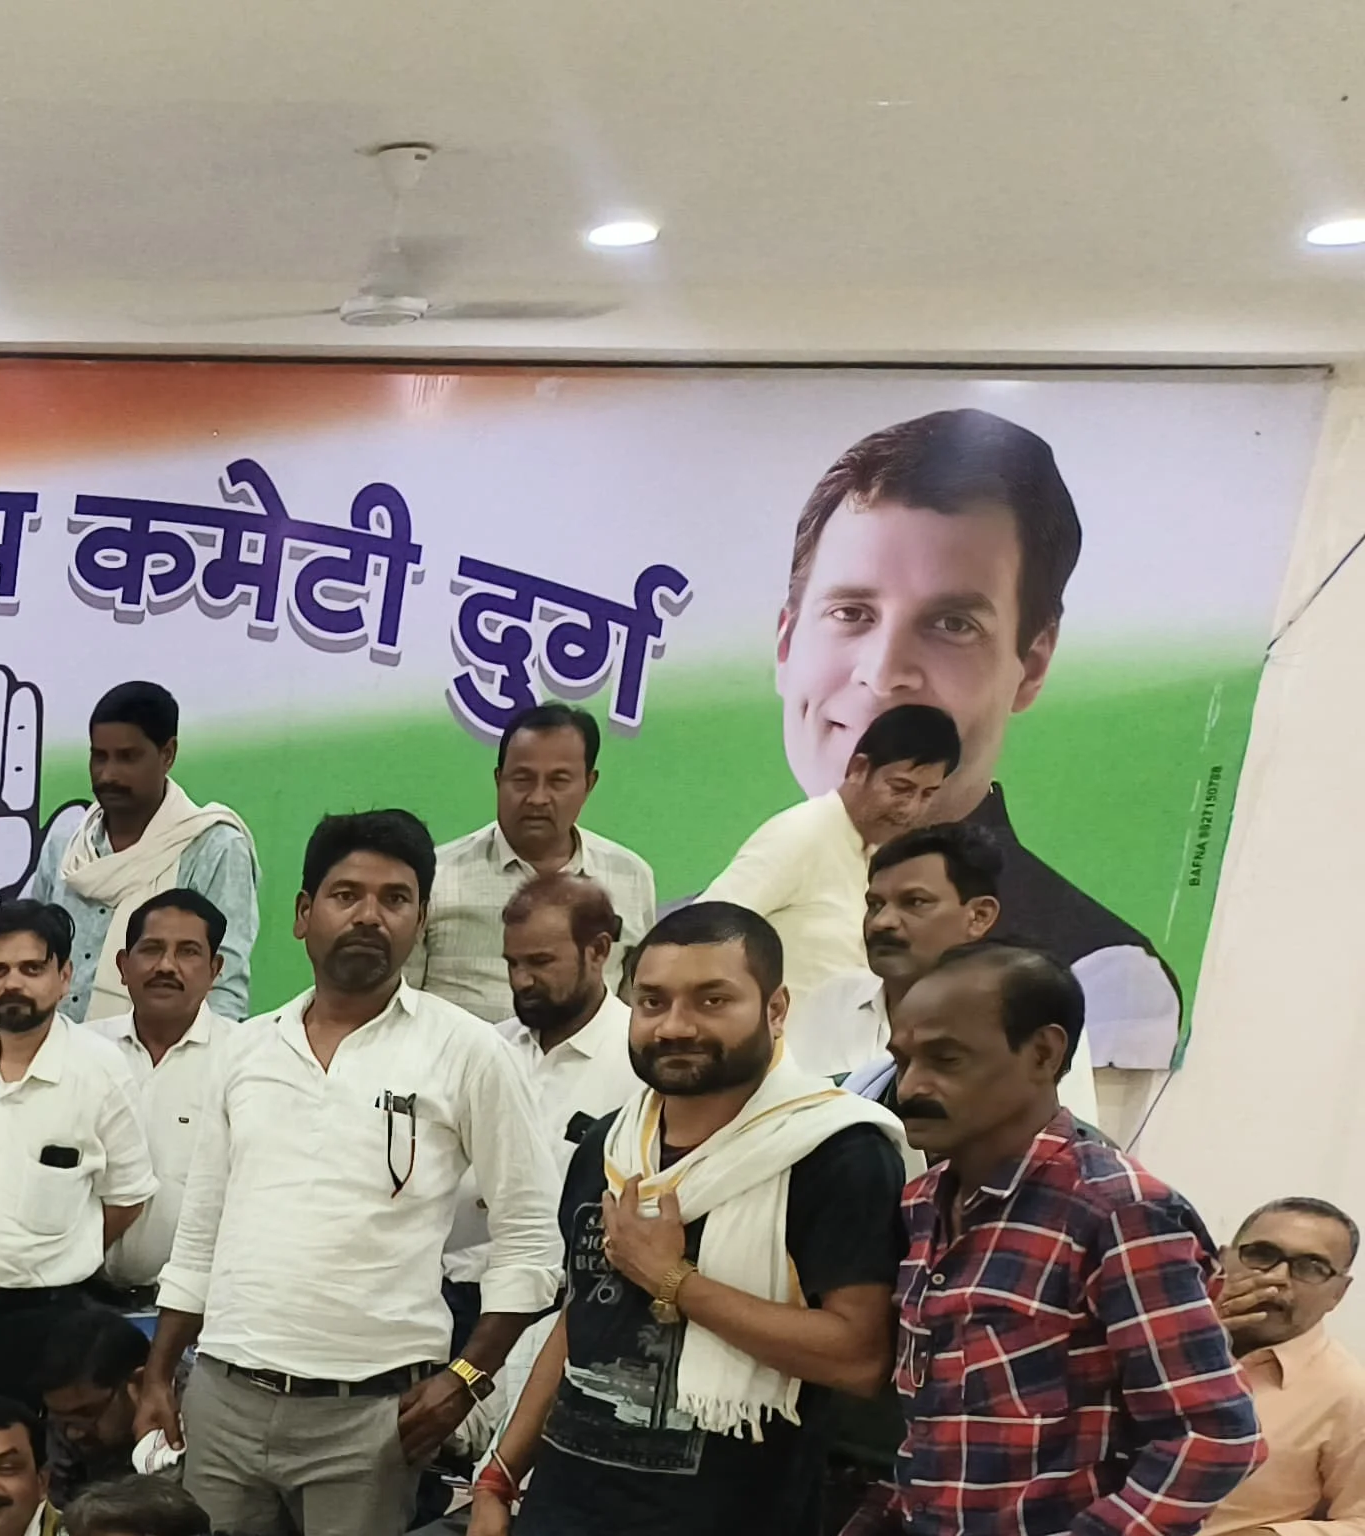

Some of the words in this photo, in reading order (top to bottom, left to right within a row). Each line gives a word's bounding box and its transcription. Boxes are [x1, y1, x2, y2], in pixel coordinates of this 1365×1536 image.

[69, 457, 423, 662] कमेटी
[447, 556, 691, 742] दुर्ग
[1189, 841, 1209, 886] BAFNA
